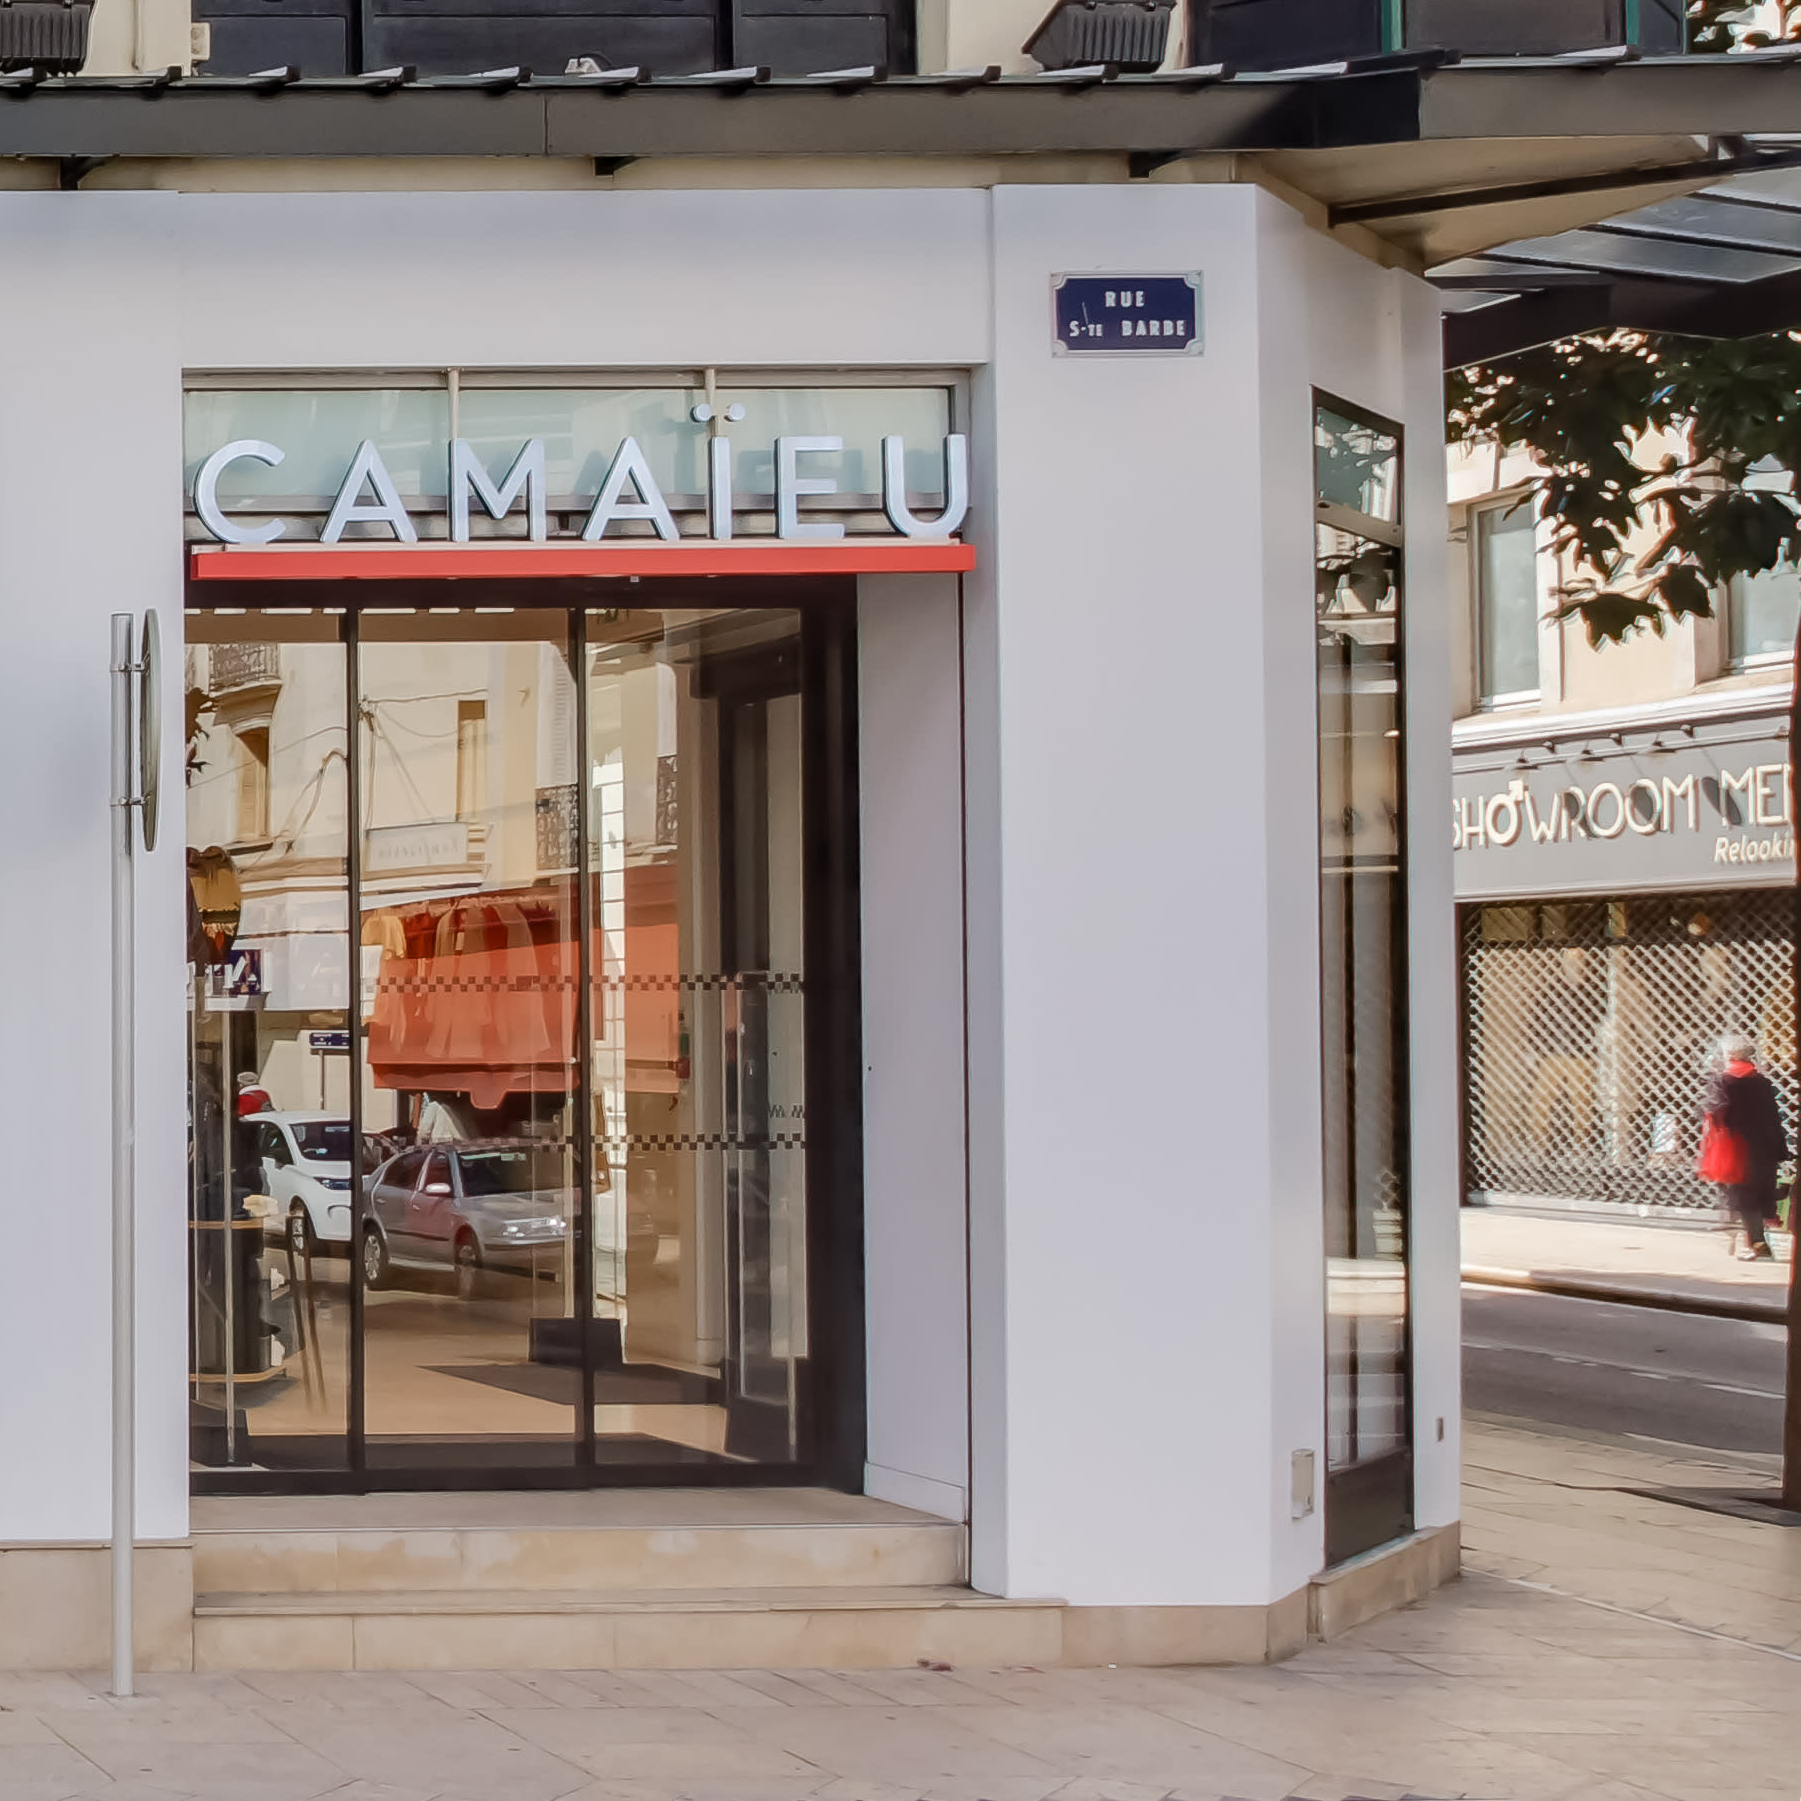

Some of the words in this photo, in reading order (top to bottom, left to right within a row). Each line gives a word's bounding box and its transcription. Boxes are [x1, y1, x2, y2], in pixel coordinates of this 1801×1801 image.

[1104, 290, 1145, 308] RUE
[1121, 319, 1186, 337] BARBE
[194, 402, 968, 544] CAMAÏEU
[1720, 763, 1792, 827] ME
